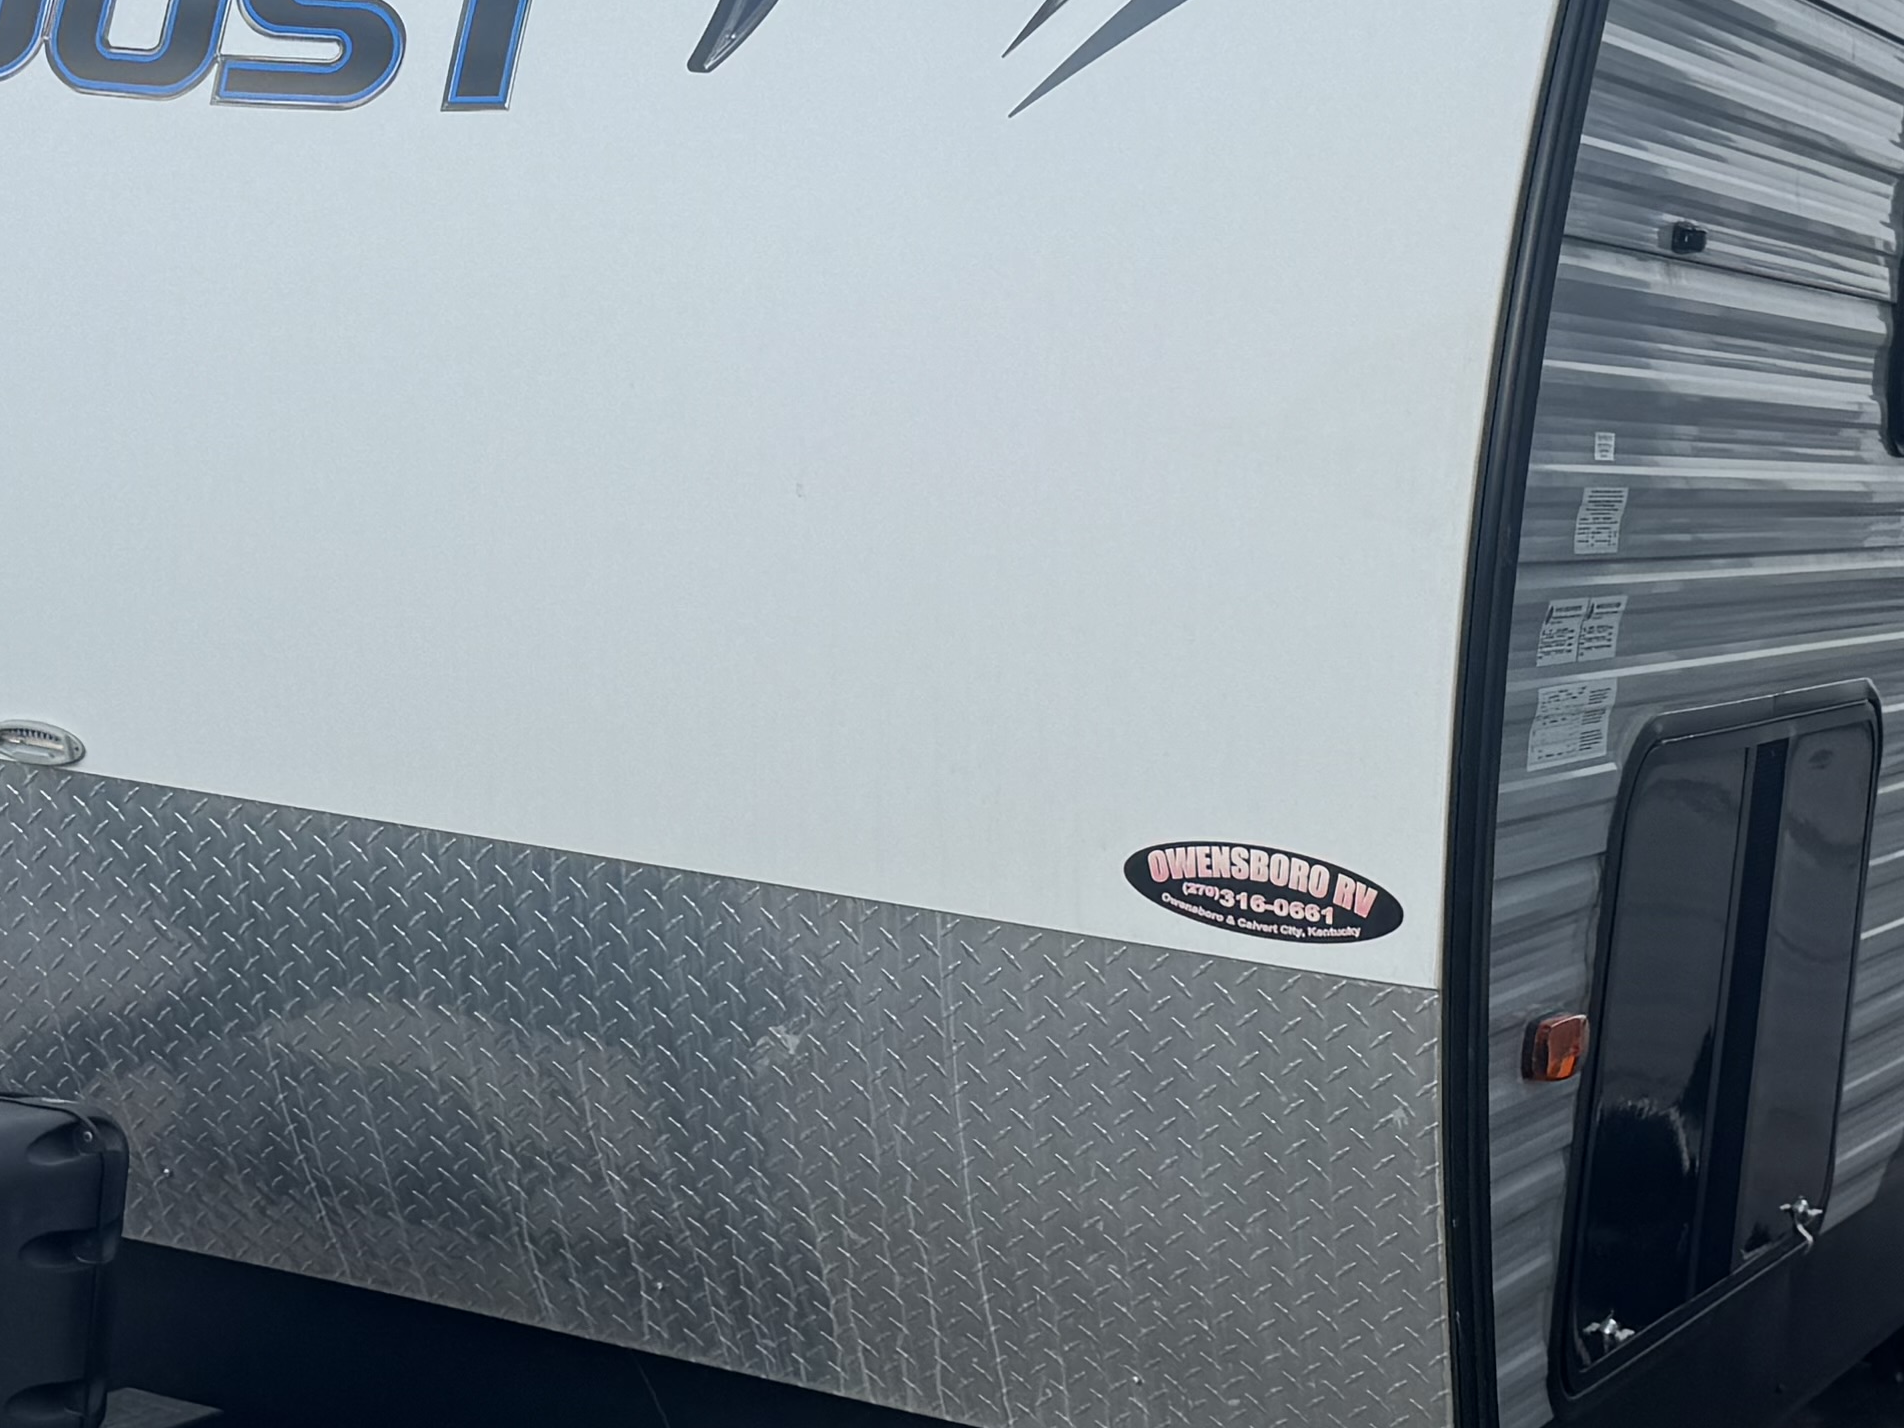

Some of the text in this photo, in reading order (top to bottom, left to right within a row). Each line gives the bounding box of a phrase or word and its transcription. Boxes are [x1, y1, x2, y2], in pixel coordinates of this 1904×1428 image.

[1147, 846, 1378, 918] OWENSBORO RV
[1161, 892, 1224, 922] Owensboro
[1237, 918, 1278, 934] Calvert
[1308, 927, 1361, 938] Kentucky
